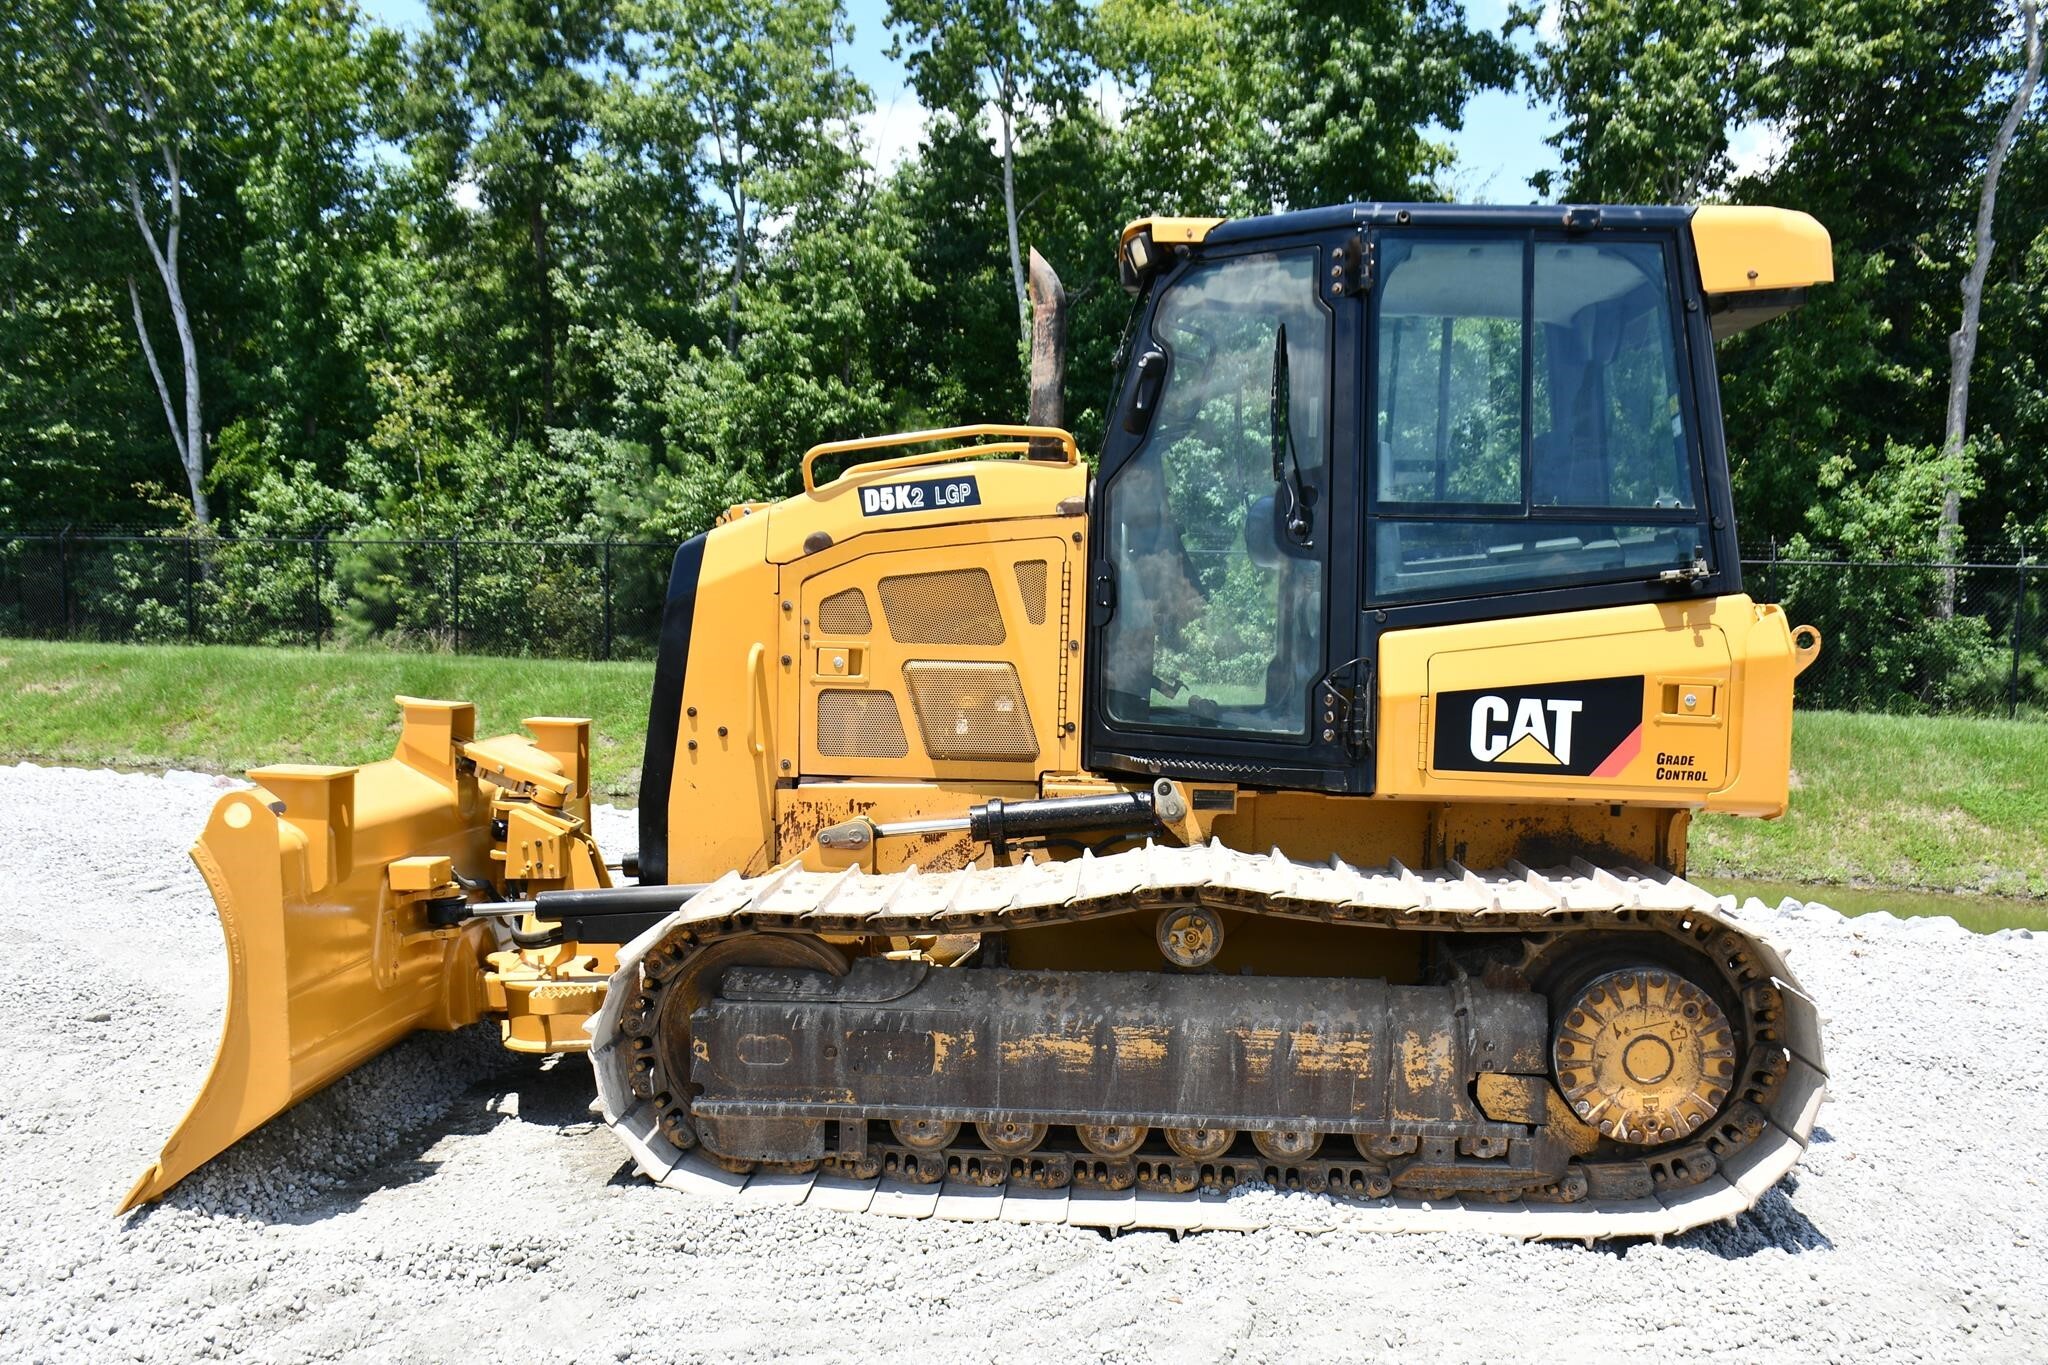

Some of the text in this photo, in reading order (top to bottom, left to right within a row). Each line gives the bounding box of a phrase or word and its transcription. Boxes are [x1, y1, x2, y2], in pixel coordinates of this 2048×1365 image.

[864, 483, 971, 513] D5K2 LGP
[1470, 695, 1583, 766] CAT
[1656, 752, 1695, 766] GRADE
[1656, 767, 1708, 781] CONTROL
